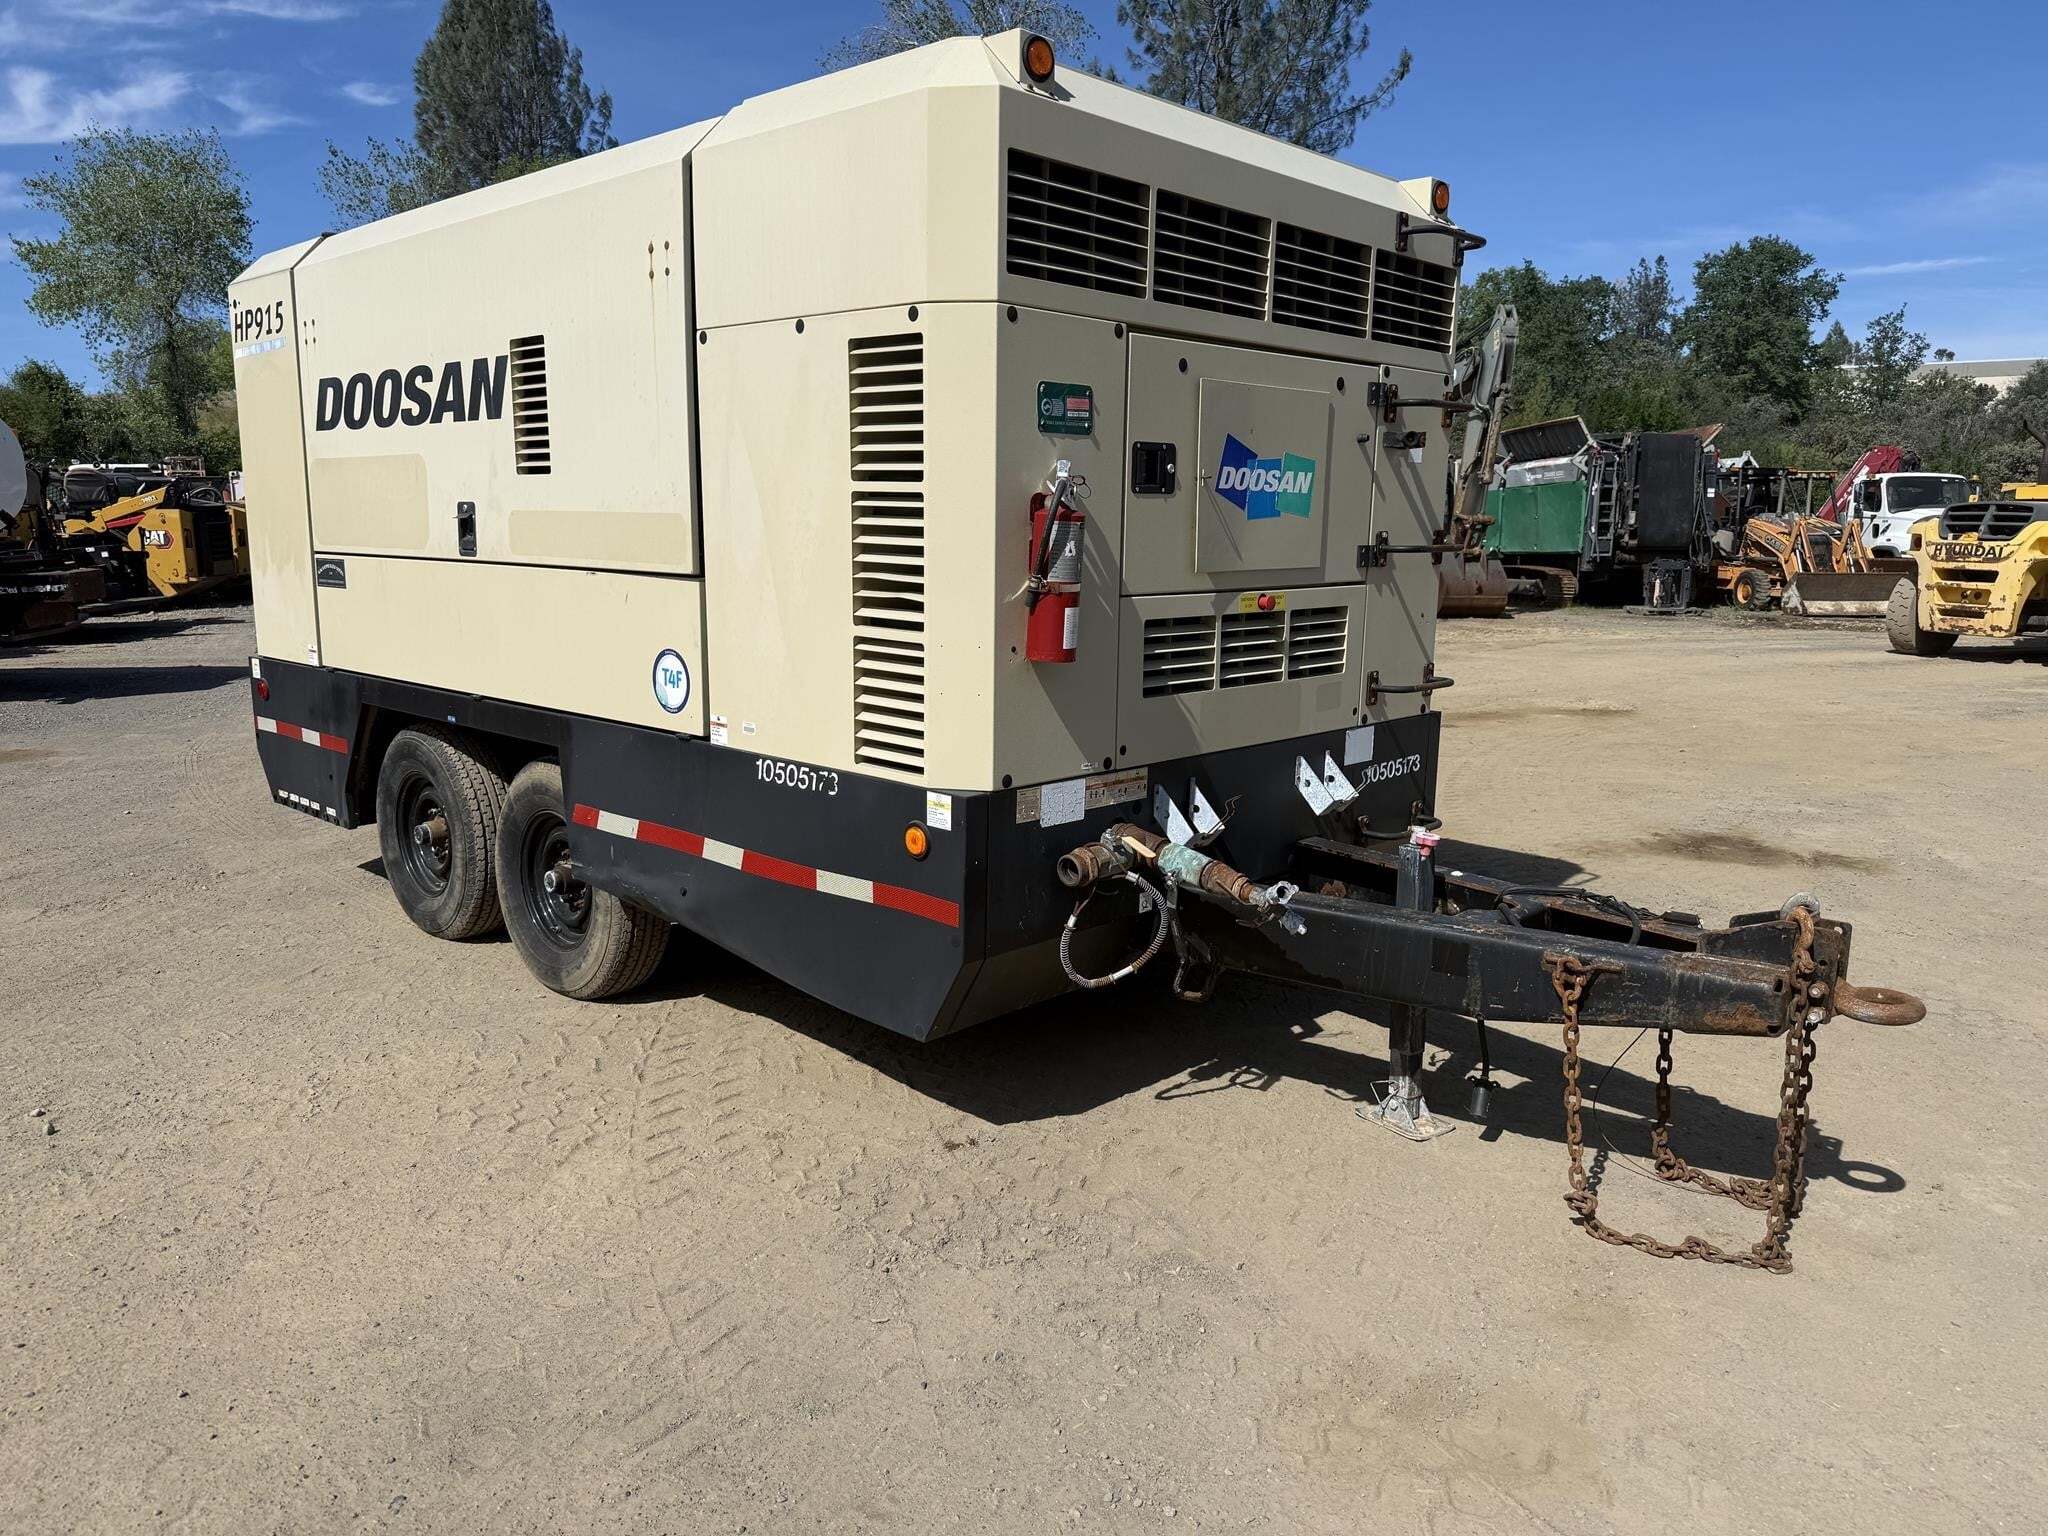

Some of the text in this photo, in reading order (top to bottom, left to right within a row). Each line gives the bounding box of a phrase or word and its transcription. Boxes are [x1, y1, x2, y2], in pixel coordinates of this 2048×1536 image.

[234, 300, 284, 343] HP915
[315, 354, 508, 432] DOOSAN
[1218, 466, 1313, 494] DOOSAN
[144, 530, 165, 545] CAT
[1933, 542, 2004, 559] HYUNDAI
[661, 667, 683, 689] T4F
[756, 758, 838, 795] 10505173
